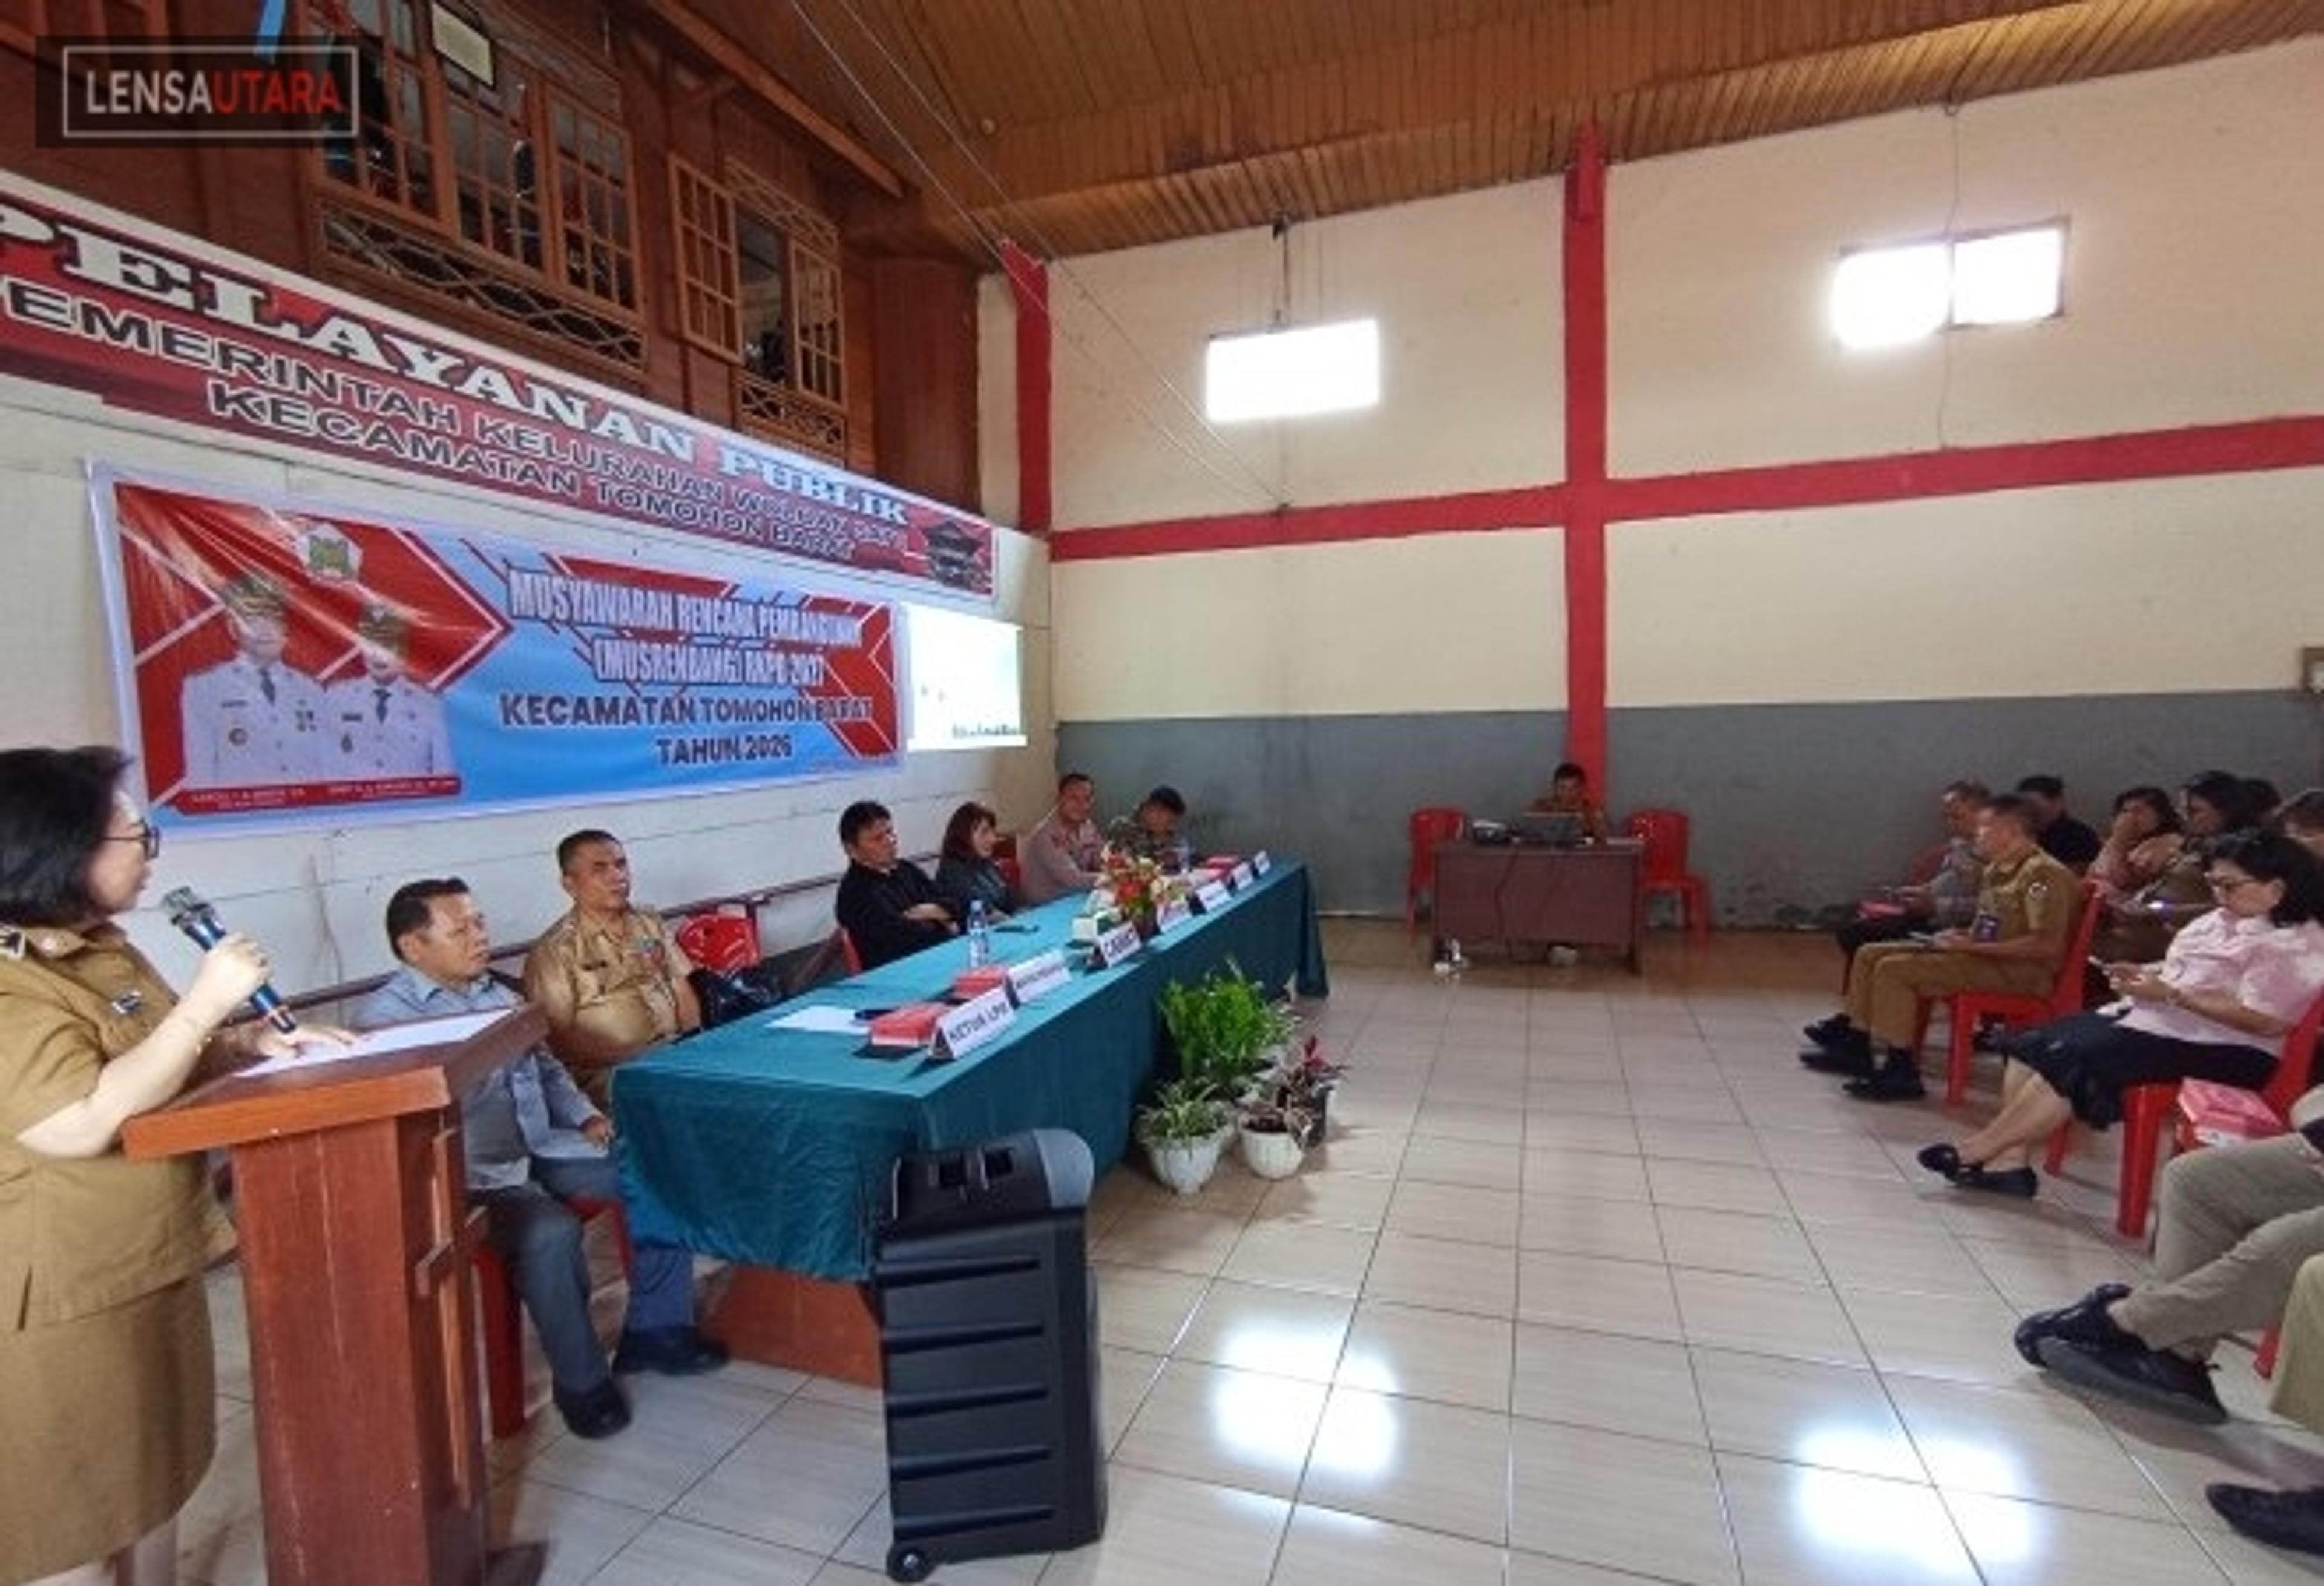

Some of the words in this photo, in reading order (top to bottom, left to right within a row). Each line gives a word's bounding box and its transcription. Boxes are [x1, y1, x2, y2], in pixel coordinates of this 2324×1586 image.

[0, 275, 461, 436] EMERINTAH
[474, 411, 725, 504] KELURAHAN
[207, 378, 582, 499] KECAMATAN
[592, 477, 763, 536] TOMOHON
[719, 447, 908, 525] PUBLIK
[509, 568, 673, 628] MUSYAWARAH
[499, 694, 698, 726] KECAMATAN
[701, 696, 812, 722] TOMOHON
[815, 696, 873, 722] BARAT
[657, 738, 744, 765] TAHUN
[746, 734, 793, 759] 2026
